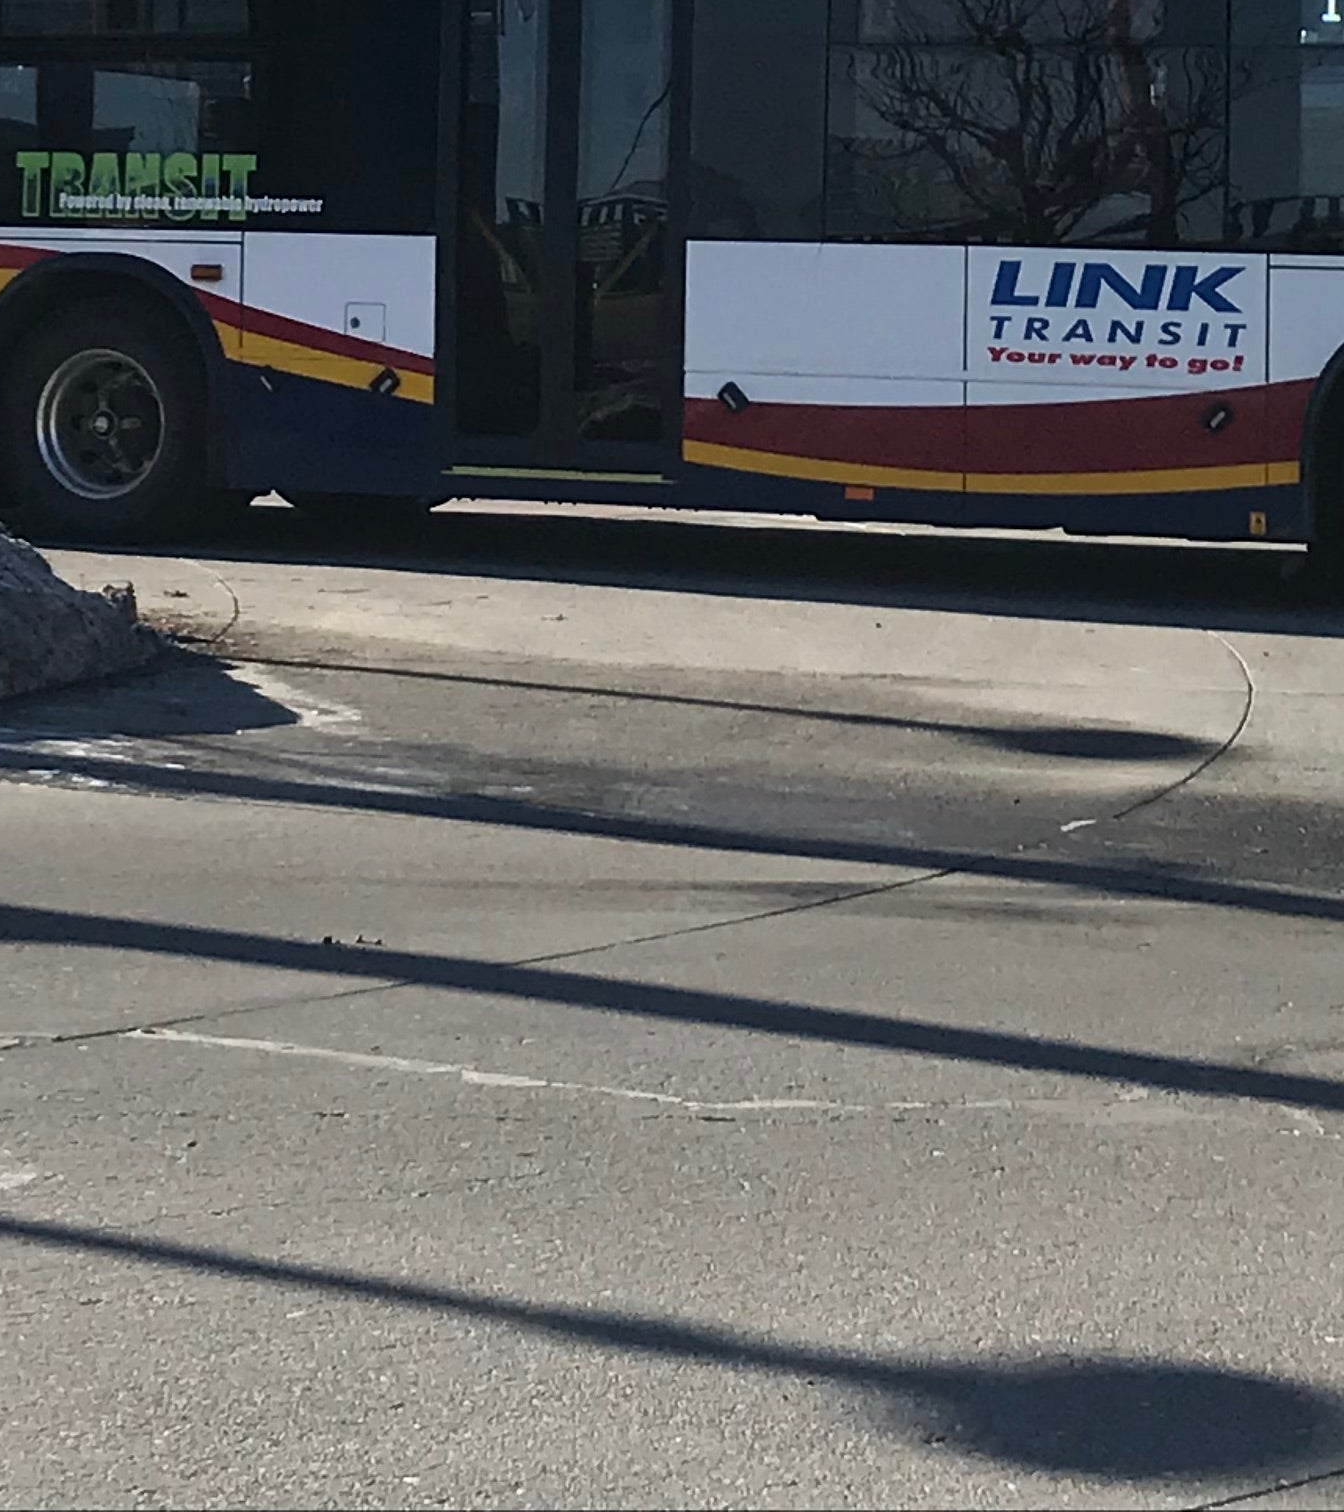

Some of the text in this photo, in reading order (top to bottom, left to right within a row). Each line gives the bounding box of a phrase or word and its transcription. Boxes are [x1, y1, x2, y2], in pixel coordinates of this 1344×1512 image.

[16, 151, 258, 222] TRANSIT
[58, 191, 114, 211] Powered
[115, 192, 132, 212] by
[174, 194, 243, 212] renewable
[244, 194, 324, 215] hydropower
[990, 259, 1248, 314] LINK
[989, 315, 1248, 349] TRANSIT
[987, 345, 1245, 375] Your way to go!
